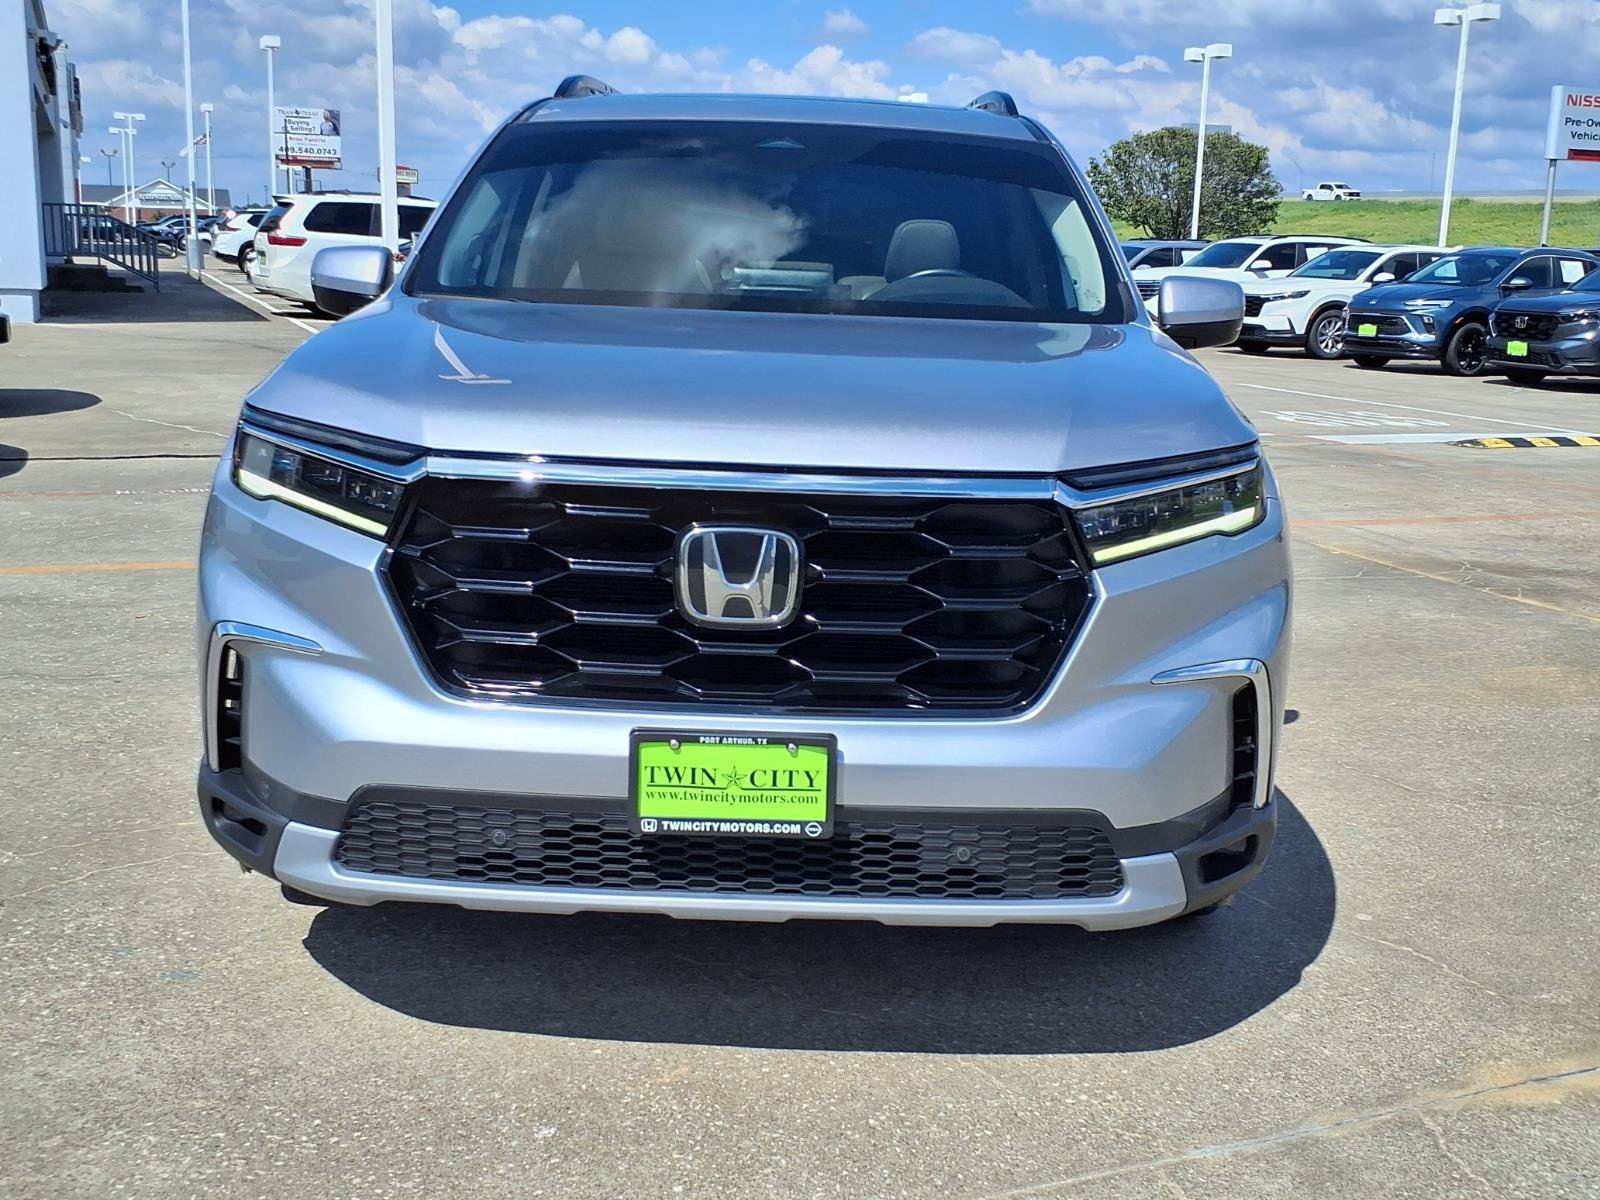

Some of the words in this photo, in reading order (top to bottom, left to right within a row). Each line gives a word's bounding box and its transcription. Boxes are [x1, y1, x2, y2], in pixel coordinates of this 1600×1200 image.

[1566, 94, 1600, 108] NISS
[1570, 130, 1600, 141] Vehic
[700, 736, 720, 744] PORT
[644, 765, 718, 786] TWIN
[749, 769, 822, 788] CITY
[645, 790, 818, 806] www.twincitymotors.com
[661, 820, 801, 834] TWINCITYMOTORS.COM
